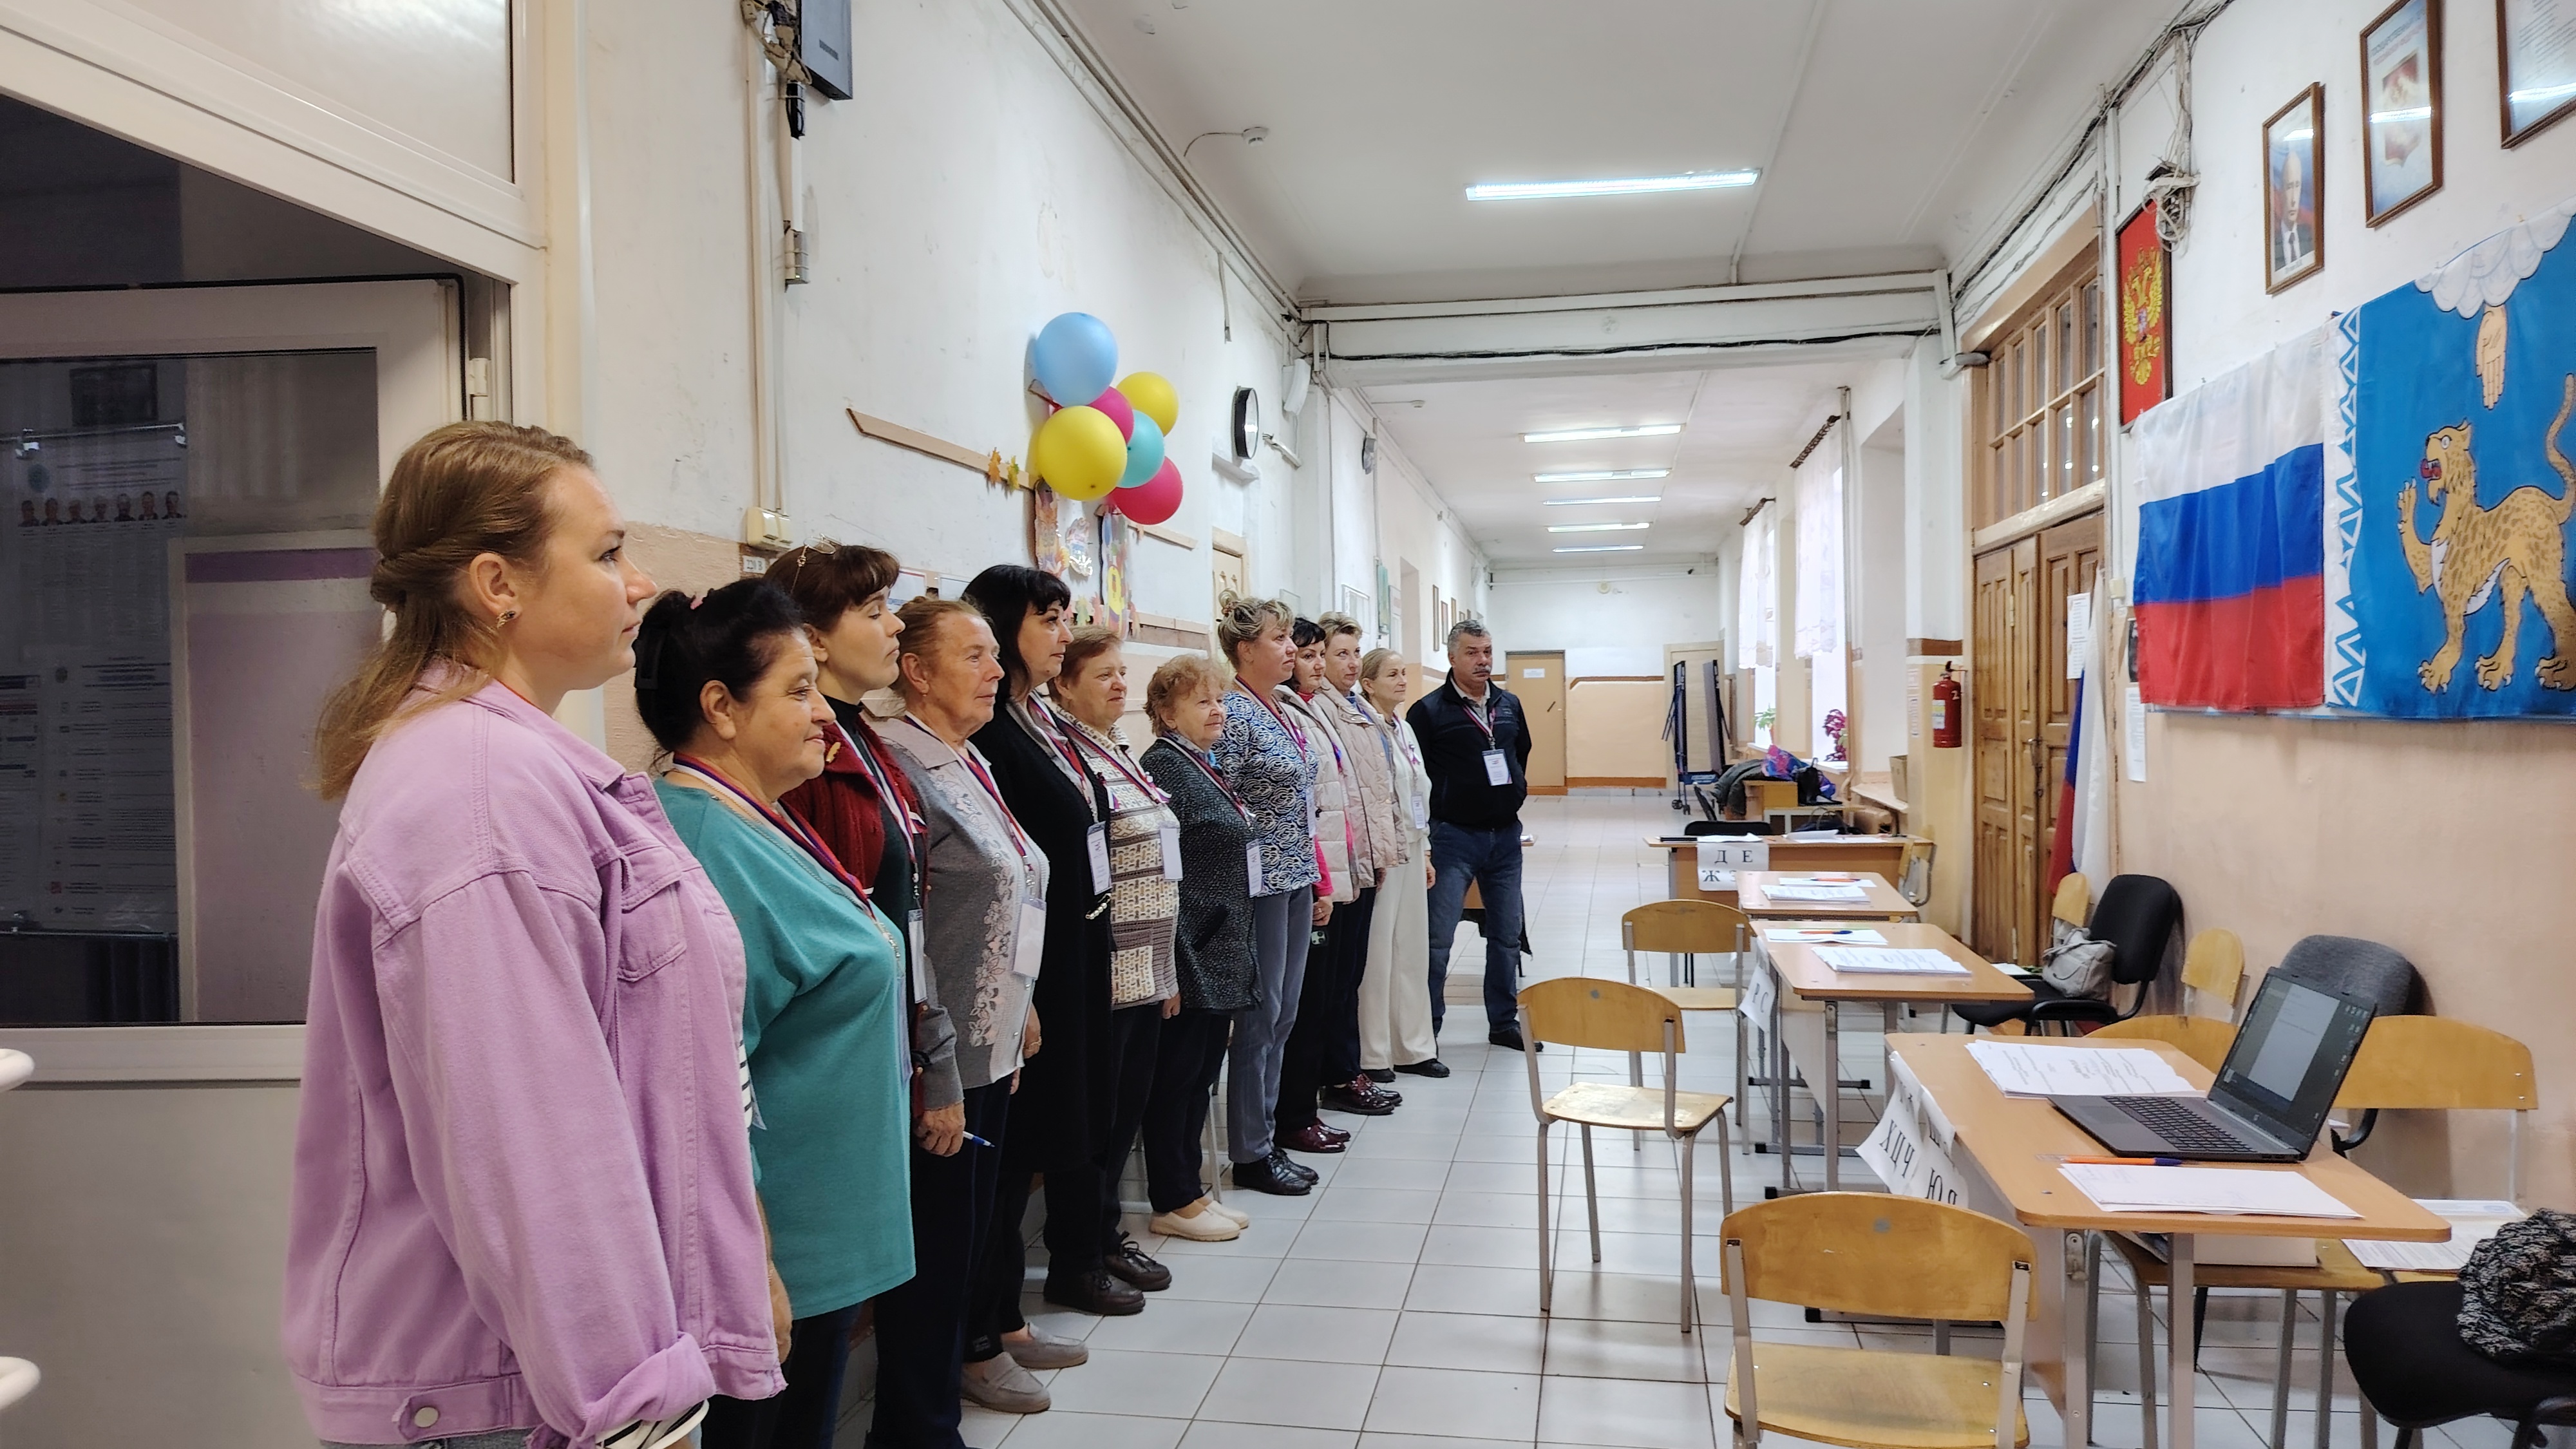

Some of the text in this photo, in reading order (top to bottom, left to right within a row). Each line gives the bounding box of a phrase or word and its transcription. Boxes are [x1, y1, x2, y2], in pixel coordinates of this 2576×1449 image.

[1714, 849, 1753, 864] Д Е
[1701, 870, 1721, 882] Ж
